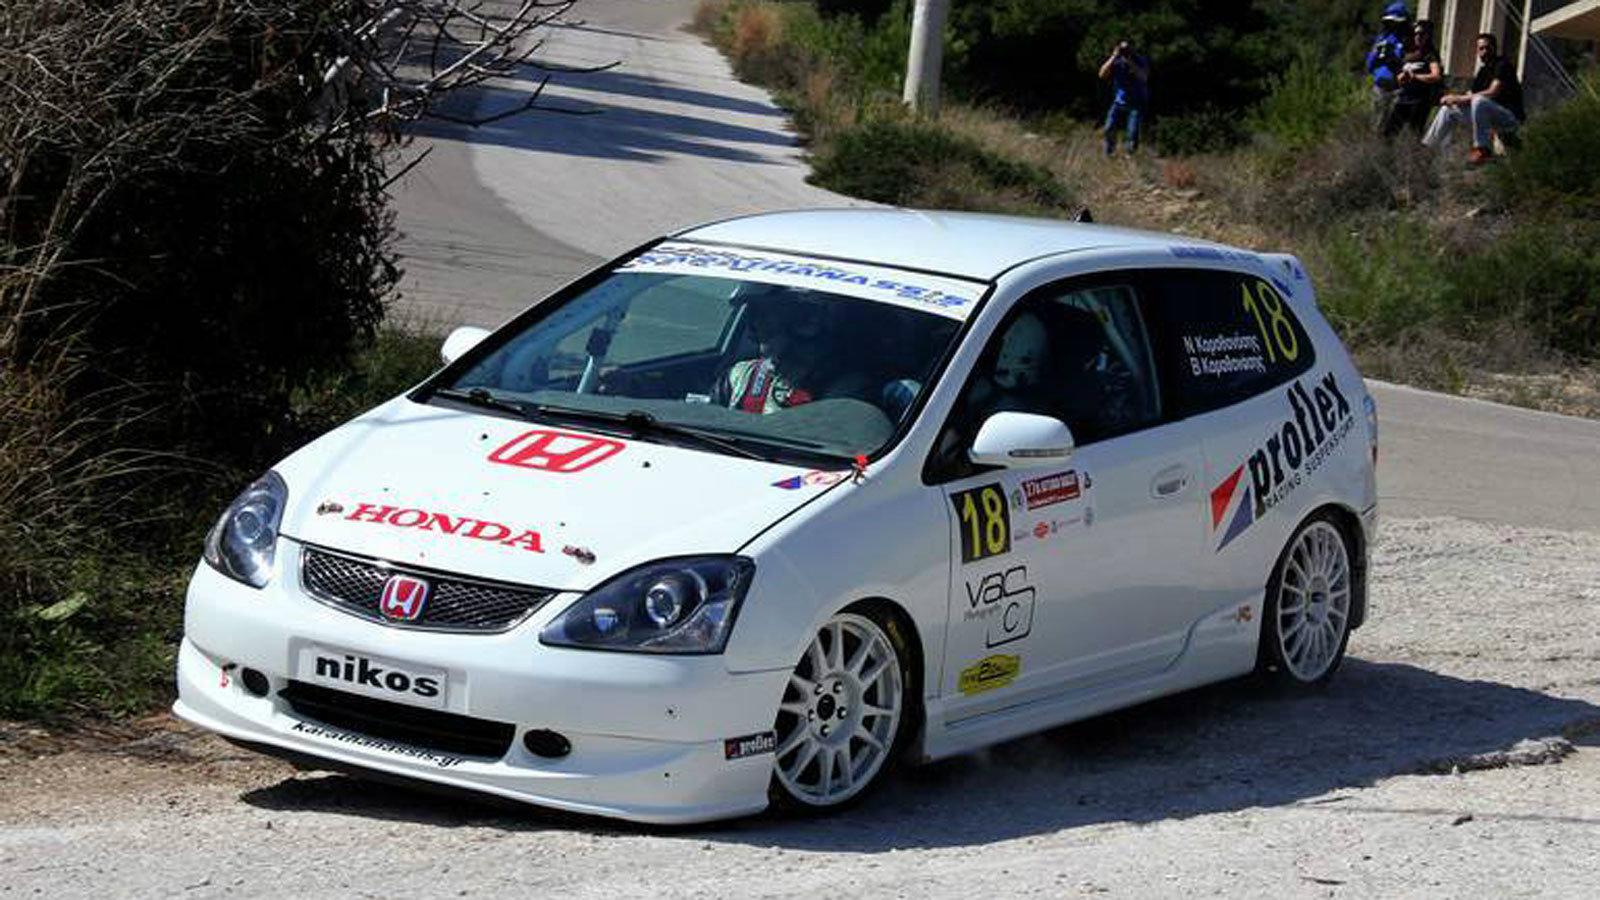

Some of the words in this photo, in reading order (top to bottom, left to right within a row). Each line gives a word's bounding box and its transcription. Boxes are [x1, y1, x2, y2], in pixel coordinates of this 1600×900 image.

[1240, 280, 1298, 363] 18
[1247, 371, 1350, 521] proflex
[344, 502, 546, 554] HONDA
[961, 485, 1008, 559] 18
[314, 653, 440, 698] nikos
